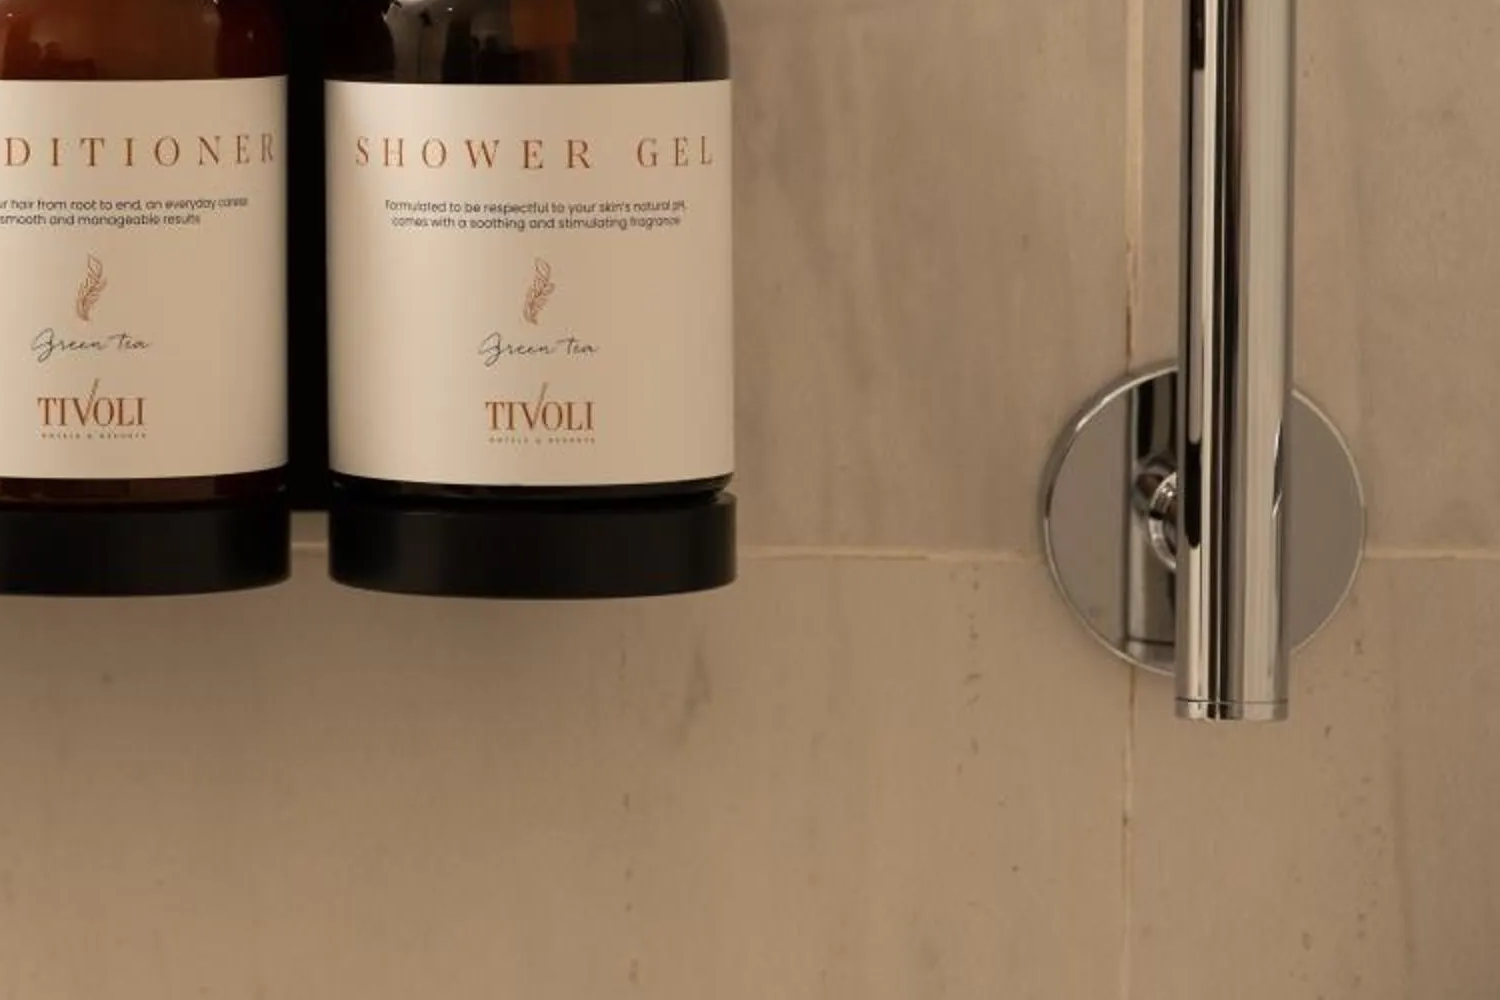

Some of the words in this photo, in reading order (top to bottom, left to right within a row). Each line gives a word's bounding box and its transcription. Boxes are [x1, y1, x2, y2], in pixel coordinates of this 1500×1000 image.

[354, 136, 592, 170] SHOWER
[635, 135, 714, 169] GEL
[0, 214, 47, 225] smooth
[49, 214, 76, 225] and
[77, 214, 161, 228] manageable
[162, 213, 201, 225] results
[10, 198, 36, 210] hair
[37, 199, 67, 211] from
[70, 200, 97, 210] root
[99, 200, 114, 211] to
[145, 200, 164, 210] an
[165, 199, 217, 211] everyday
[385, 199, 448, 213] Formulated
[449, 202, 463, 213] to
[464, 202, 482, 213] be
[483, 202, 550, 216] respectful
[550, 202, 566, 213] to
[567, 202, 597, 215] your
[632, 200, 671, 212] natural
[391, 216, 429, 227] comes
[430, 216, 456, 227] with
[457, 218, 468, 228] a
[469, 217, 527, 231] soothing
[528, 217, 556, 229] and
[557, 216, 627, 231] stimulating
[629, 215, 681, 230] fragrance
[31, 327, 109, 363] Green
[107, 332, 153, 351] Tea
[477, 331, 557, 368] Green
[555, 336, 600, 355] Tea
[37, 378, 145, 427] TIVOLI
[485, 382, 595, 431] TIVOLI
